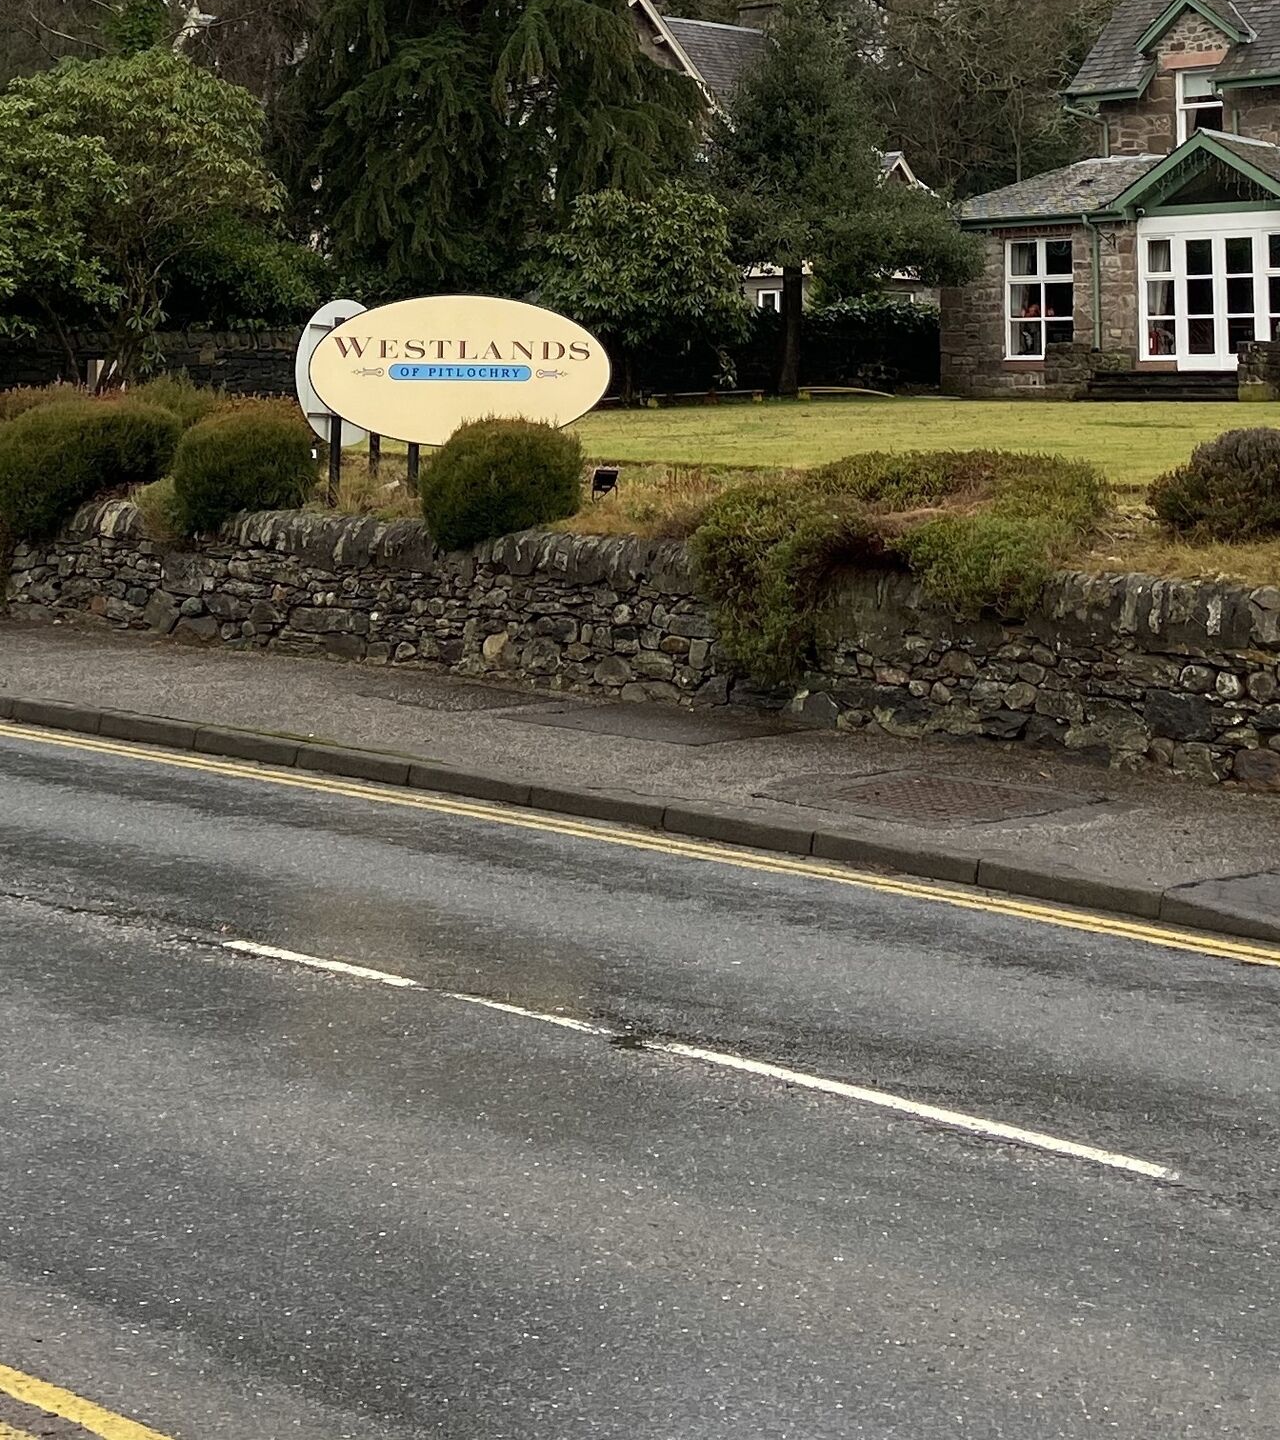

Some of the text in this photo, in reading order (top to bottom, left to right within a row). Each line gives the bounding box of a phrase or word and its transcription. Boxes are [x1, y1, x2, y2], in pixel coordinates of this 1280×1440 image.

[332, 336, 591, 361] WESTLANDS
[400, 367, 521, 378] OF PITLOCHRY
